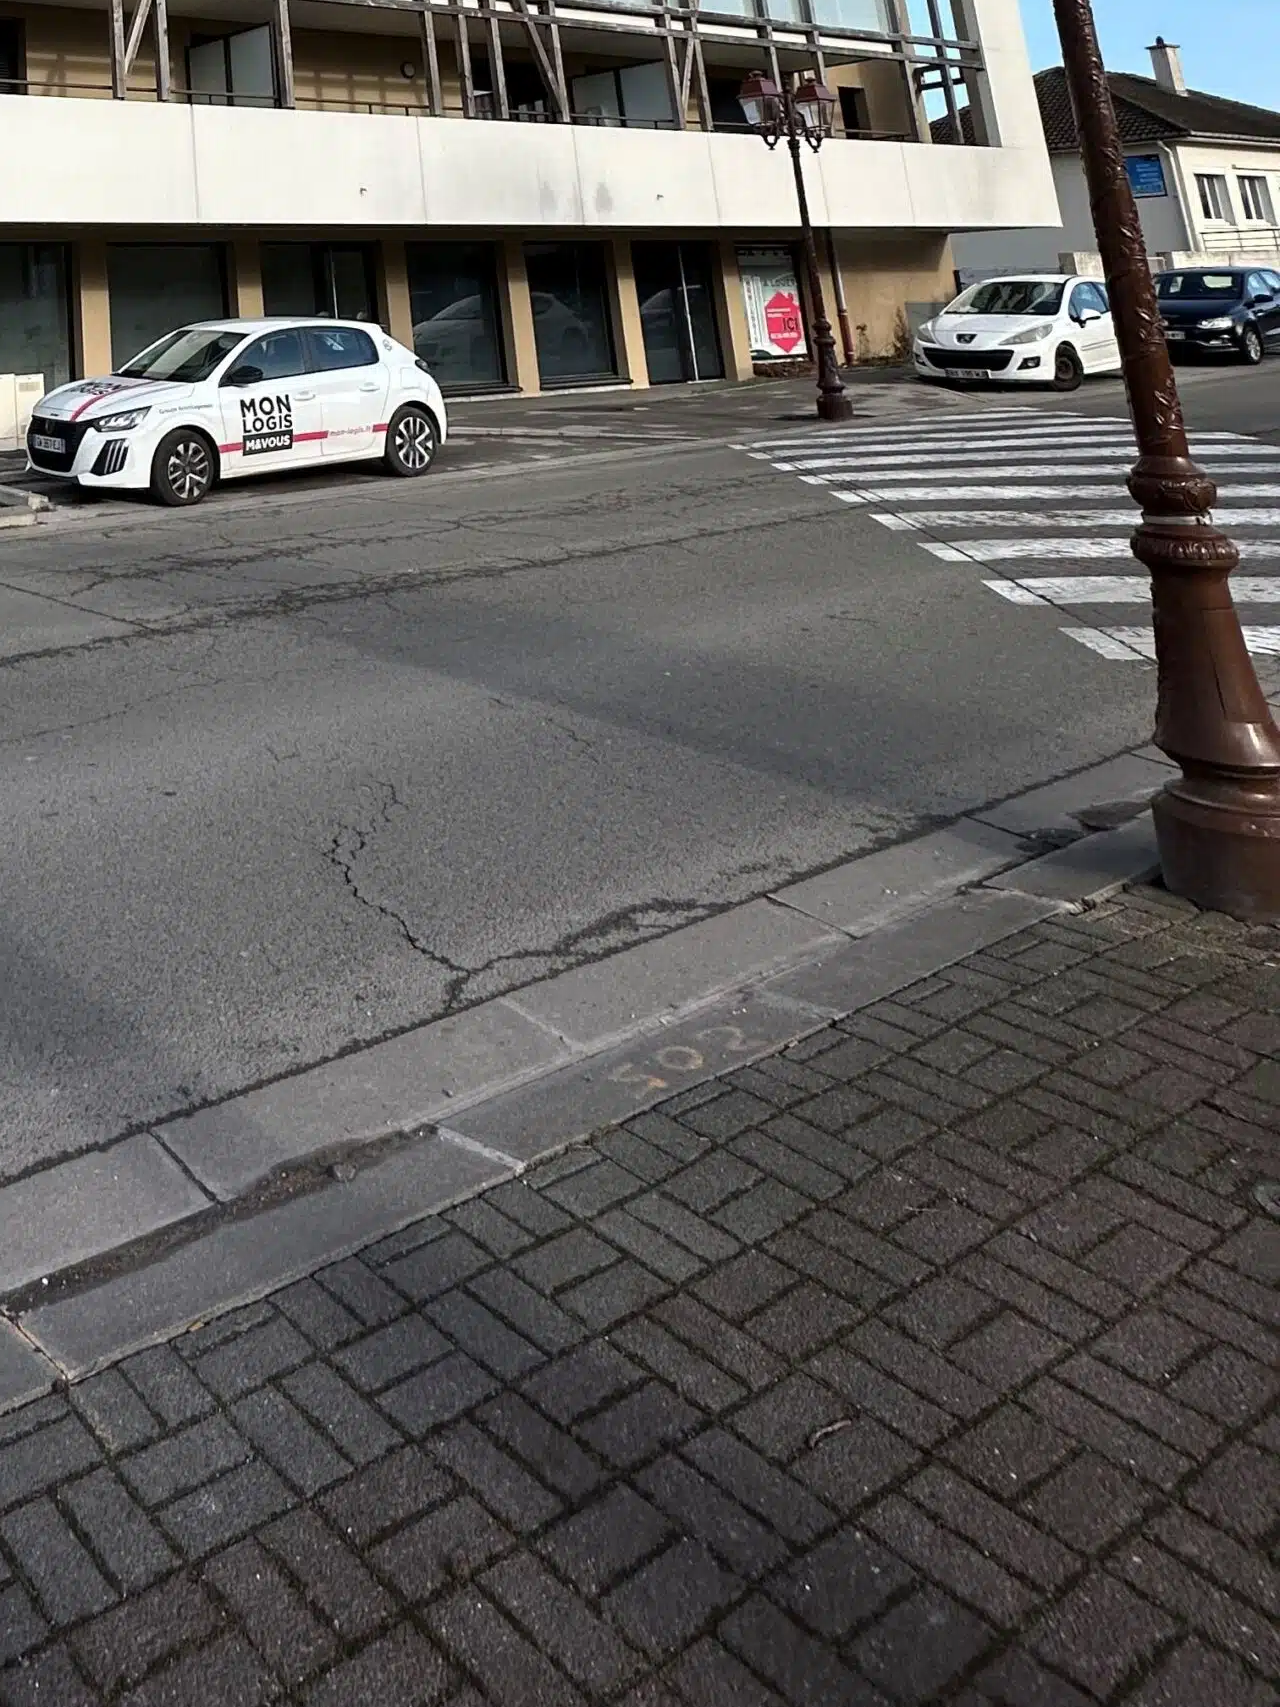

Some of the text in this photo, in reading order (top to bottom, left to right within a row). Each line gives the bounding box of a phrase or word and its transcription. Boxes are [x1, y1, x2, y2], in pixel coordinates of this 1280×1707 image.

[783, 318, 799, 331] ICI
[240, 394, 292, 418] MON
[242, 413, 293, 434] LOGIS
[245, 434, 291, 451] M&VOUS
